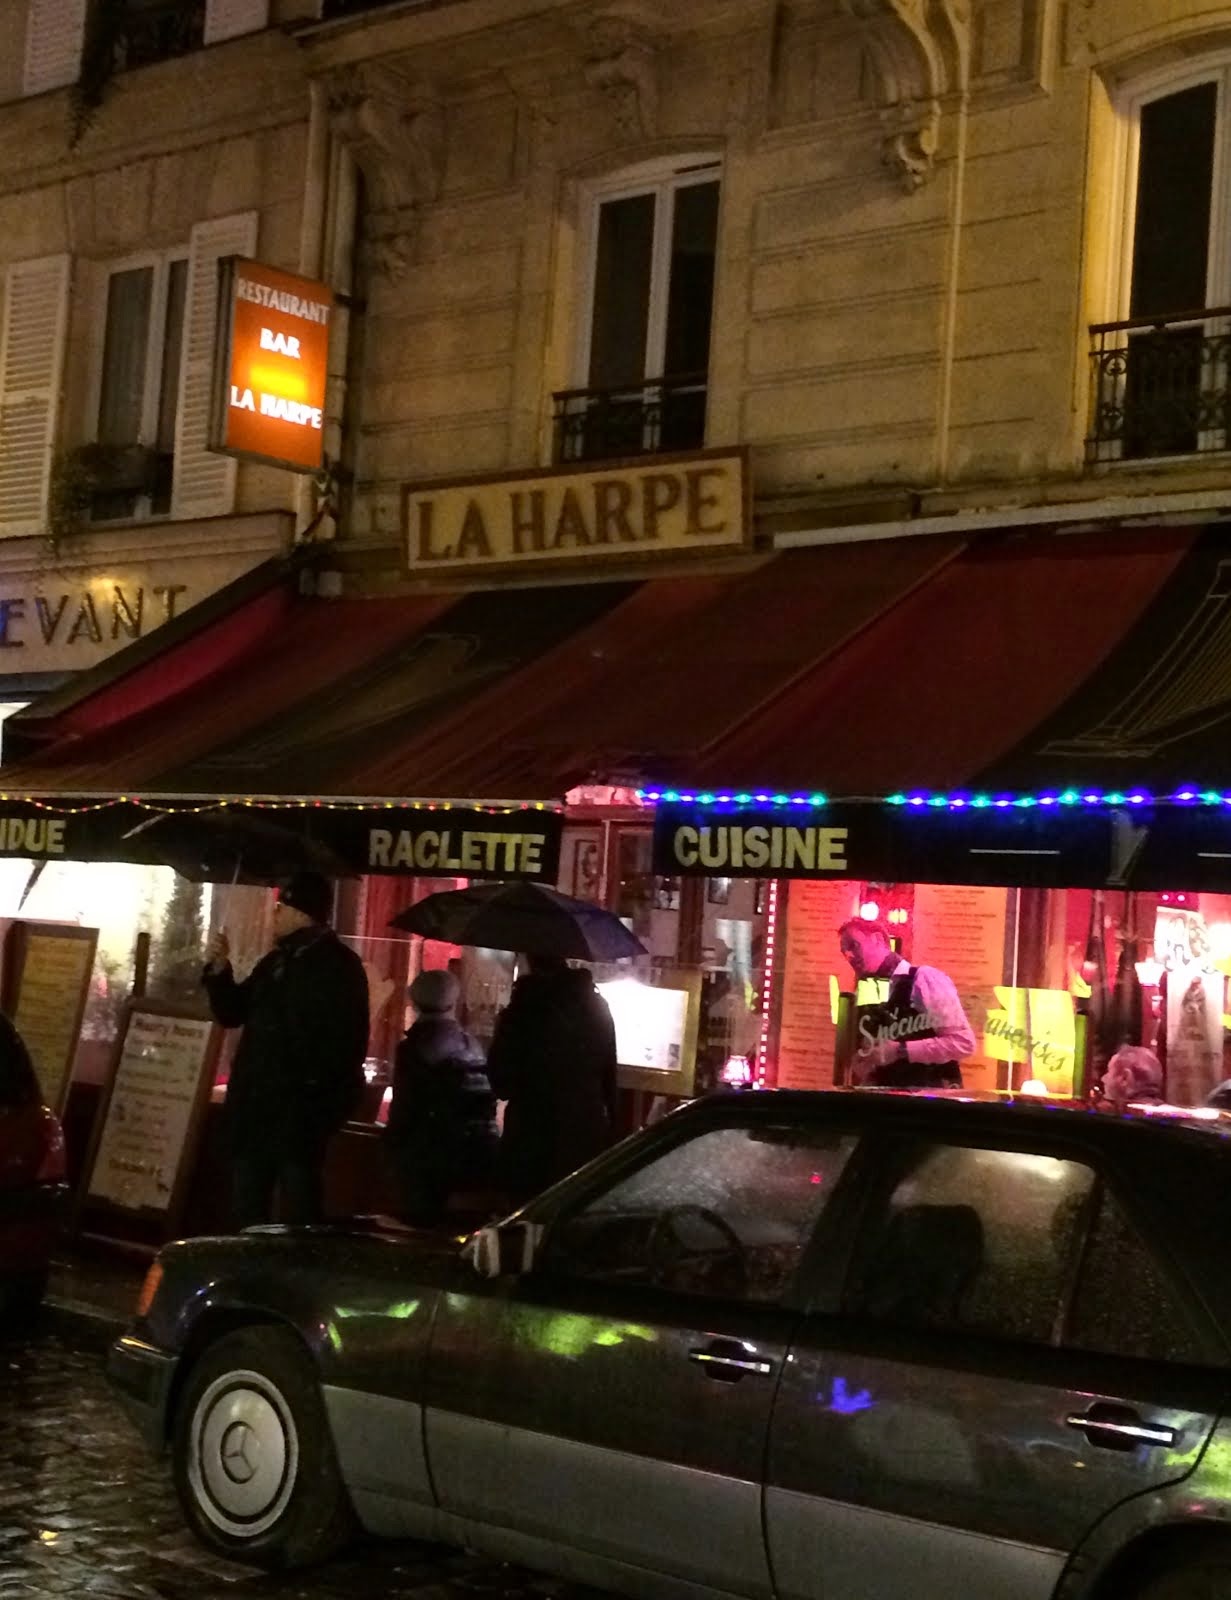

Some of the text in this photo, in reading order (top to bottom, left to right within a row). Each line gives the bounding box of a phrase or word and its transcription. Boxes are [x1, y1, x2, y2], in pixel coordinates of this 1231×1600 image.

[237, 277, 330, 325] RESTAURANT
[259, 327, 301, 359] BAR
[230, 385, 323, 429] LA HARPE
[415, 467, 728, 561] LA HARPE
[0, 584, 187, 647] EVANT
[369, 829, 546, 873] RACLETTE
[673, 825, 849, 871] CUISINE
